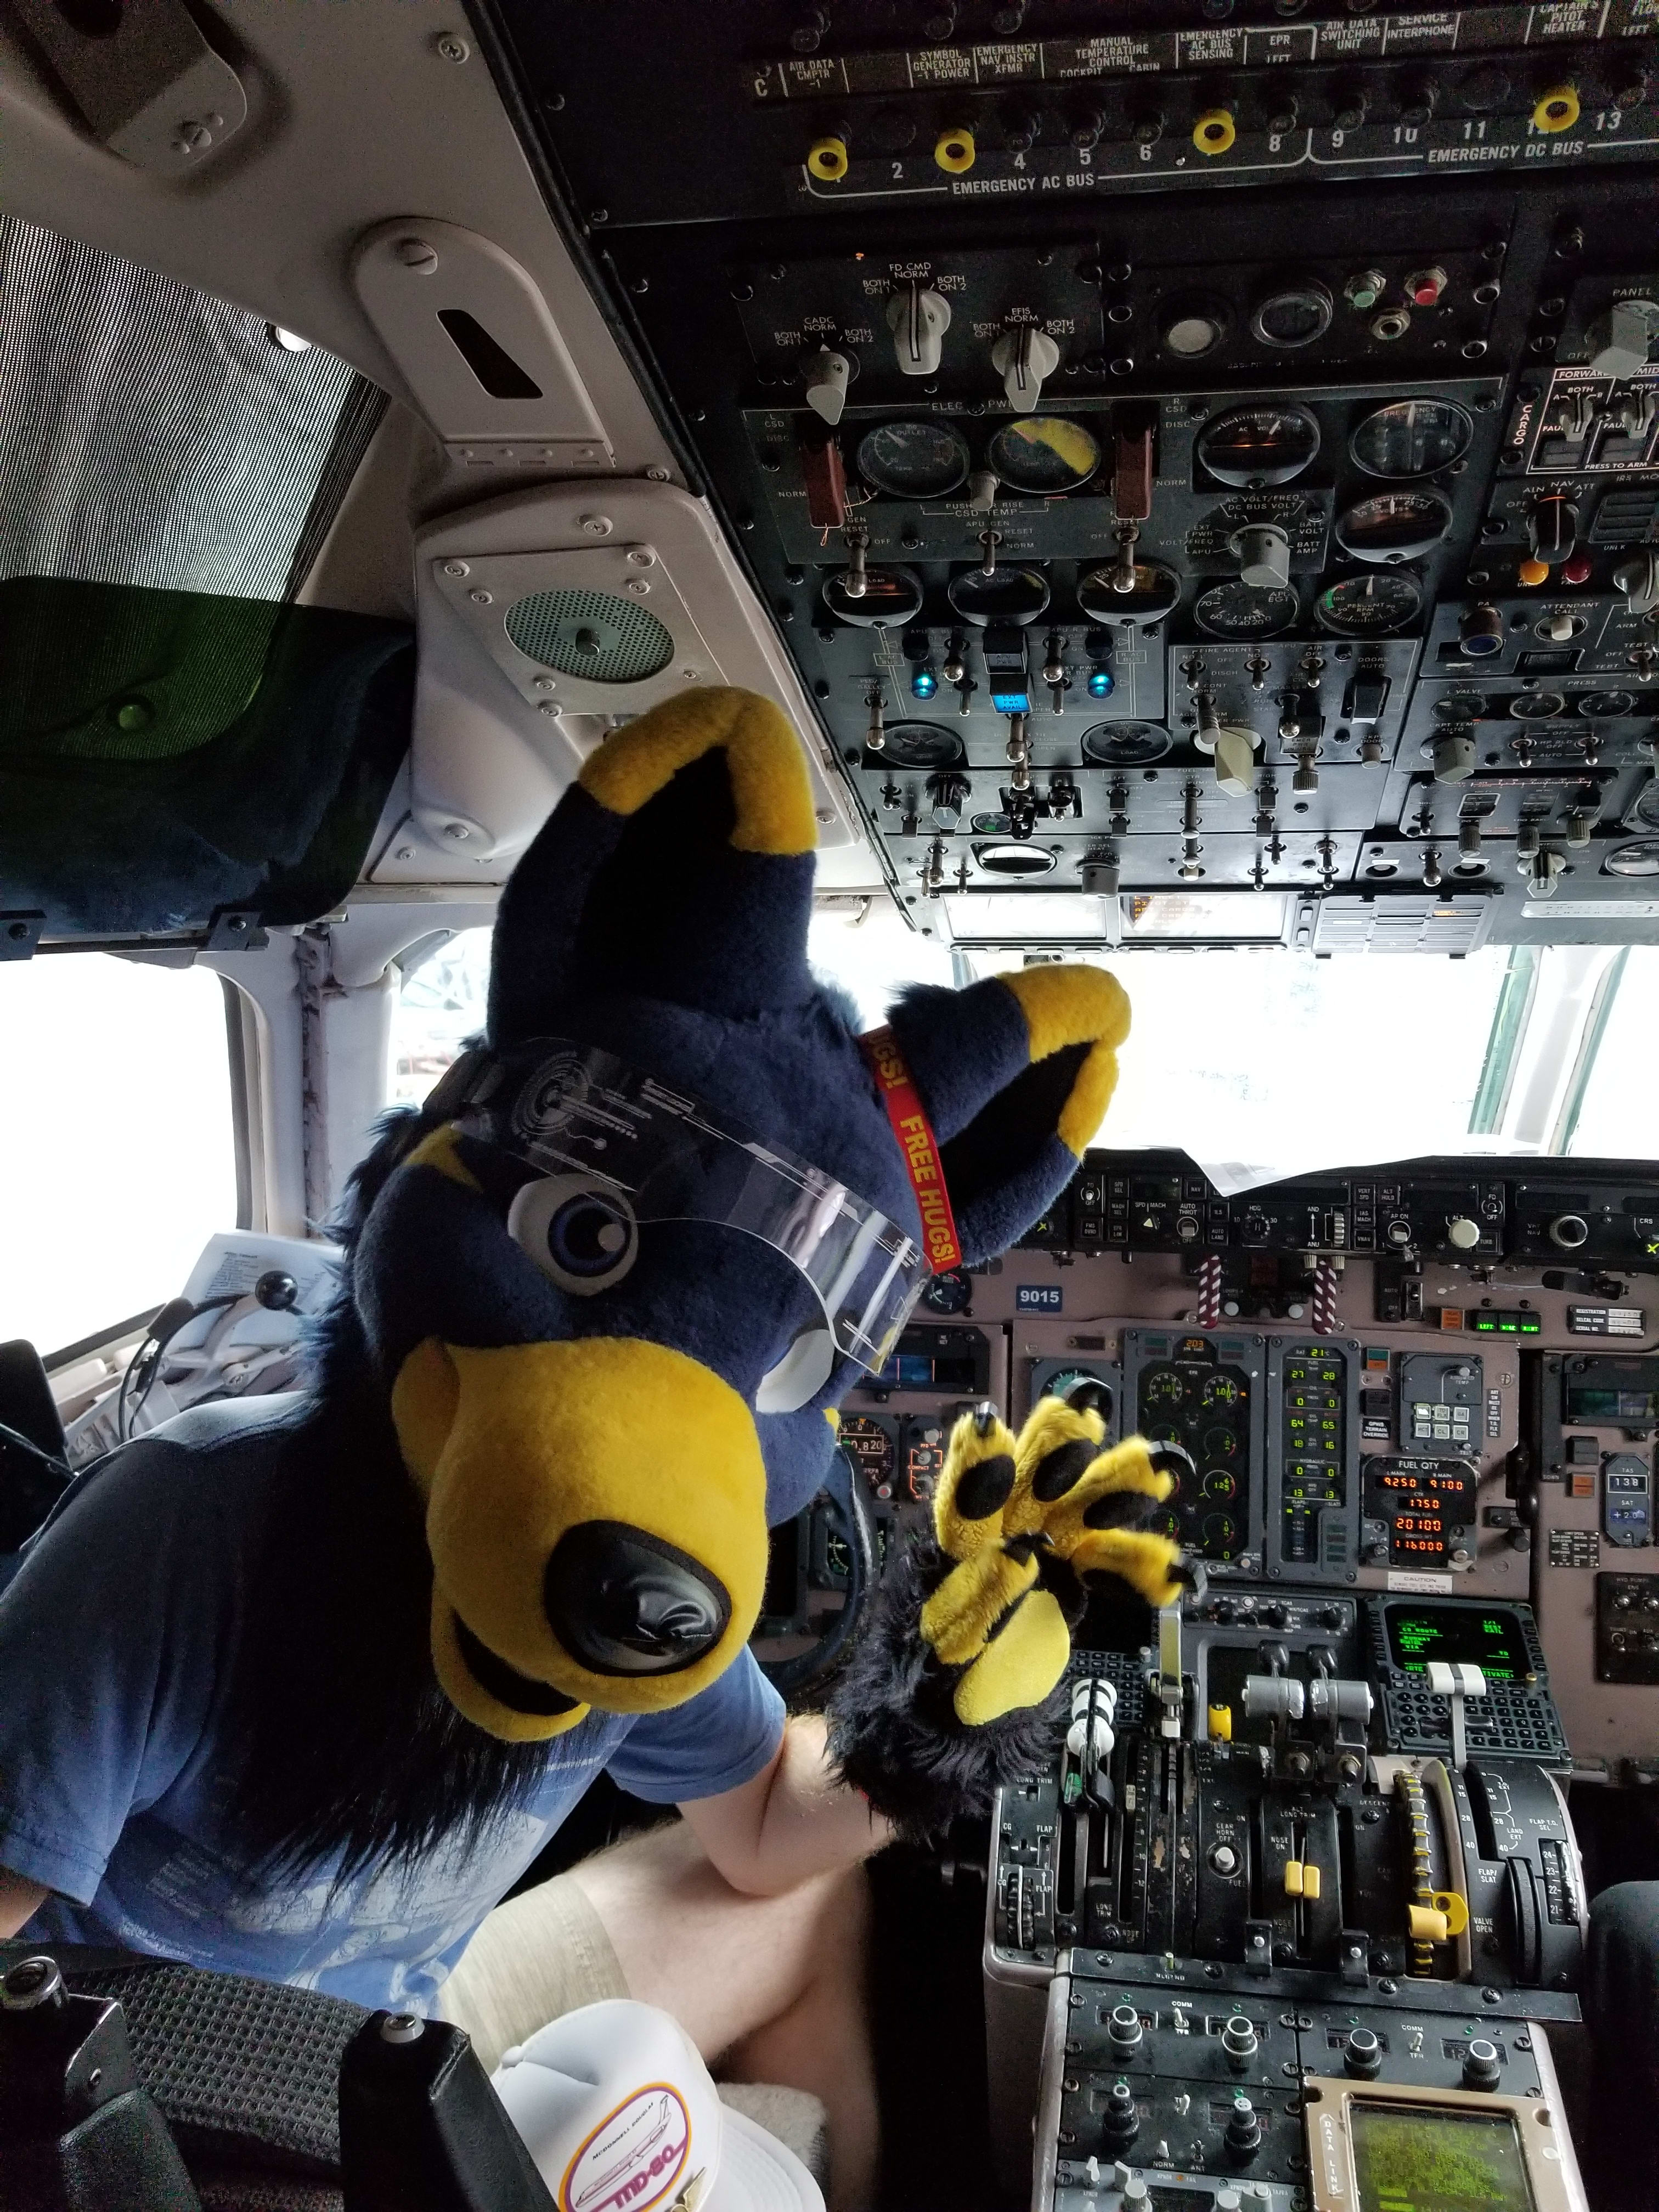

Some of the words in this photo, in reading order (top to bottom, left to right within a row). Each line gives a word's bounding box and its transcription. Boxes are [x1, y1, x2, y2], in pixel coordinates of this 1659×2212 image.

[1399, 13, 1447, 25] SERVICE
[1181, 28, 1243, 41] EMERGENCY
[1321, 27, 1380, 41] SWITCHING
[1388, 25, 1454, 39] INTERPHONE
[1091, 37, 1133, 47] MANUAL
[1193, 41, 1205, 49] AC
[1211, 38, 1231, 48] BUS
[1269, 35, 1290, 46] EPR
[1337, 39, 1361, 50] UNIT
[920, 49, 962, 60] SYMBOL
[978, 44, 1037, 55] EMERGENCY
[1076, 44, 1149, 59] TEMPERATURE
[1188, 49, 1233, 60] SENSING
[789, 61, 805, 71] AIR
[810, 59, 834, 69] DATA
[913, 58, 970, 71] GENERATOR
[981, 56, 1000, 65] NAV
[1006, 54, 1035, 63] INSTR
[1090, 55, 1136, 67] CONTROL
[934, 68, 969, 78] POWER
[995, 64, 1023, 74] XFMR
[1060, 67, 1102, 77] COCKPIT
[1269, 135, 1281, 151] 8
[1333, 130, 1344, 148] 9
[1464, 121, 1486, 139] 11
[1597, 112, 1622, 131] 13
[1429, 146, 1518, 163] EMERGENCY
[1526, 145, 1546, 157] DC
[1552, 142, 1583, 155] BUS
[892, 162, 903, 179] 2
[1014, 154, 1025, 170] 4
[1080, 150, 1091, 165] 5
[1141, 144, 1152, 160] 6
[953, 178, 1036, 195] EMERGENCY
[1042, 177, 1061, 189] AC
[1066, 174, 1094, 188] BUS
[863, 279, 890, 287] BOTH
[937, 275, 965, 284] BOTH
[1613, 287, 1651, 297] PANEL
[933, 402, 963, 410] ELEC
[1514, 405, 1532, 445] CARGO
[900, 1115, 937, 1183] FREE
[919, 1189, 956, 1263] HUGS!
[1021, 1290, 1059, 1302] 9015
[1323, 1372, 1335, 1380] 28
[1384, 1477, 1417, 1488] 9250
[1430, 1480, 1463, 1490] 9100
[1616, 1478, 1638, 1486] 138
[1410, 1499, 1439, 1509] 1750
[1324, 2121, 1334, 2151] DATA
[1330, 2160, 1339, 2192] LINK
